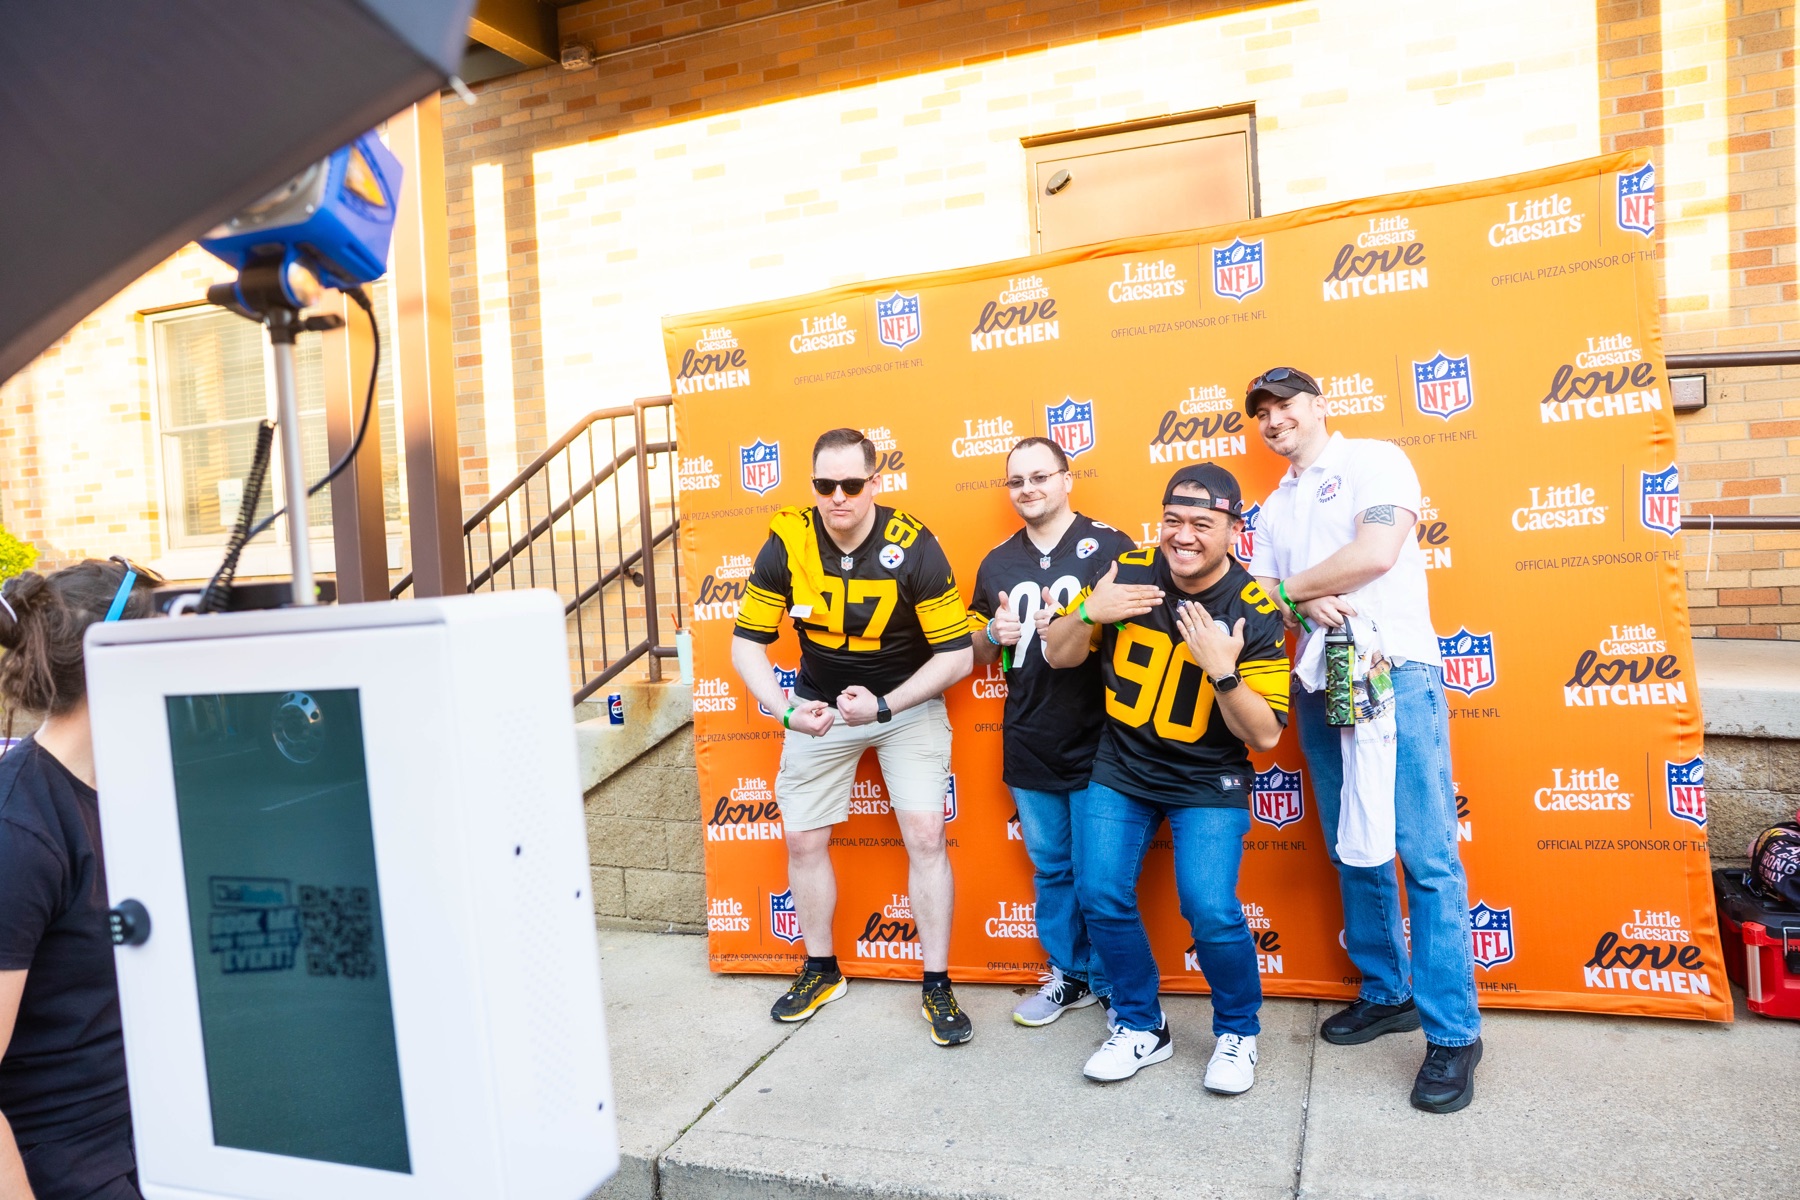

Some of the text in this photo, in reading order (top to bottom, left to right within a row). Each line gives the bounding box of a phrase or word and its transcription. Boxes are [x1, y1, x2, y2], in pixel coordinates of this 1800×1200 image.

[1507, 193, 1572, 226] Little
[1624, 194, 1654, 226] NF
[1368, 215, 1409, 234] Little
[1488, 213, 1582, 248] Caesars
[1357, 229, 1416, 249] Caesars
[1122, 259, 1176, 284] Little
[1324, 242, 1426, 283] love
[1491, 271, 1535, 287] OFFICIAL
[1537, 266, 1566, 279] PIZZA
[1568, 255, 1619, 273] SPONSOR
[1621, 252, 1636, 264] OF
[1008, 275, 1043, 292] Little
[1219, 264, 1259, 292] NFL
[1323, 267, 1429, 302] KITCHEN
[999, 287, 1049, 305] Caesars
[1108, 279, 1185, 303] Caesars
[800, 312, 847, 337] Little
[971, 298, 1057, 334] love
[1111, 310, 1267, 339] OFFICIAL PIZZA SPONSOR OF THE NFL
[702, 326, 732, 341] Little
[883, 315, 916, 342] NFL
[970, 320, 1059, 352] KITCHEN
[695, 338, 738, 352] Caesars
[789, 329, 856, 354] Caesars
[1586, 333, 1632, 354] Little
[676, 349, 747, 379] love
[1575, 348, 1642, 369] Caesars
[675, 368, 751, 396] KITCHEN
[794, 358, 924, 386] OFFICIAL PIZZA SPONSOR OF THE NFL
[1541, 362, 1657, 404] love
[1188, 384, 1226, 401] Little
[1316, 373, 1374, 399] Little
[1422, 380, 1466, 411] NFL
[1179, 399, 1233, 415] Caesars
[1326, 394, 1385, 417] esars
[1540, 388, 1663, 424] KITCHEN
[964, 416, 1013, 440] Little
[1053, 423, 1090, 451] NFL
[1150, 410, 1244, 445] love
[1381, 430, 1477, 447] NSOR OF THE NFL
[874, 439, 897, 452] sars
[1149, 435, 1247, 464] KITCHEN
[679, 473, 720, 491] esars
[746, 463, 776, 488] NFL
[955, 478, 1006, 492] OFFICIAL PIZZ
[1071, 469, 1098, 479] HE NFL
[1529, 483, 1595, 510] Little
[1512, 506, 1606, 532] Caesars
[1648, 496, 1679, 527] NF
[722, 554, 751, 568] Little
[1515, 550, 1680, 572] OFFICIAL PIZZA SPONSOR OF THE
[715, 566, 752, 580] Caesar
[694, 575, 748, 605] lov
[693, 600, 742, 622] KITCH
[1610, 624, 1656, 642] Little
[1599, 639, 1666, 656] Caesars
[1444, 657, 1490, 688] NFL
[1565, 650, 1681, 688] love
[1105, 622, 1215, 741] 90
[693, 697, 737, 712] esars
[1564, 681, 1687, 707] KITCHEN
[1460, 709, 1480, 719] THE
[1483, 708, 1501, 718] NFL
[707, 733, 726, 742] PIZZA
[727, 731, 760, 741] SPONSOR
[761, 732, 771, 740] OF
[975, 723, 1003, 732] OFFICIA
[737, 777, 767, 791] Little
[850, 780, 881, 799] ttle
[1551, 767, 1619, 791] Little
[730, 788, 772, 801] Caesars
[1534, 788, 1631, 812] Caesars
[1674, 787, 1706, 817] NF
[708, 796, 780, 826] love
[848, 800, 890, 815] esars
[1258, 793, 1298, 821] NFL
[707, 822, 783, 842] KITCHEN
[859, 838, 880, 847] PIZZA
[880, 838, 906, 847] SPONS
[946, 838, 960, 848] NFL
[1150, 840, 1174, 851] OFFIC
[1257, 841, 1270, 850] OF
[1272, 841, 1288, 850] THE
[1291, 841, 1307, 851] NFL
[1537, 840, 1707, 852] OFFICIAL PIZZA SPONSOR OF TH
[883, 904, 914, 919] Caes
[892, 894, 911, 908] Lit
[998, 901, 1037, 922] Littl
[1241, 902, 1264, 917] ttle
[708, 917, 750, 932] esars
[857, 912, 919, 943] lov
[985, 917, 1039, 938] Caesa
[1633, 909, 1681, 928] Little
[1621, 922, 1690, 943] Caesars
[799, 954, 809, 962] NF
[856, 940, 924, 961] KITCHE
[1584, 932, 1705, 970] love
[987, 961, 1045, 972] OFFICIAL PIZZA
[1479, 981, 1520, 993] THE NFL
[1583, 966, 1711, 996] KITCHEN
